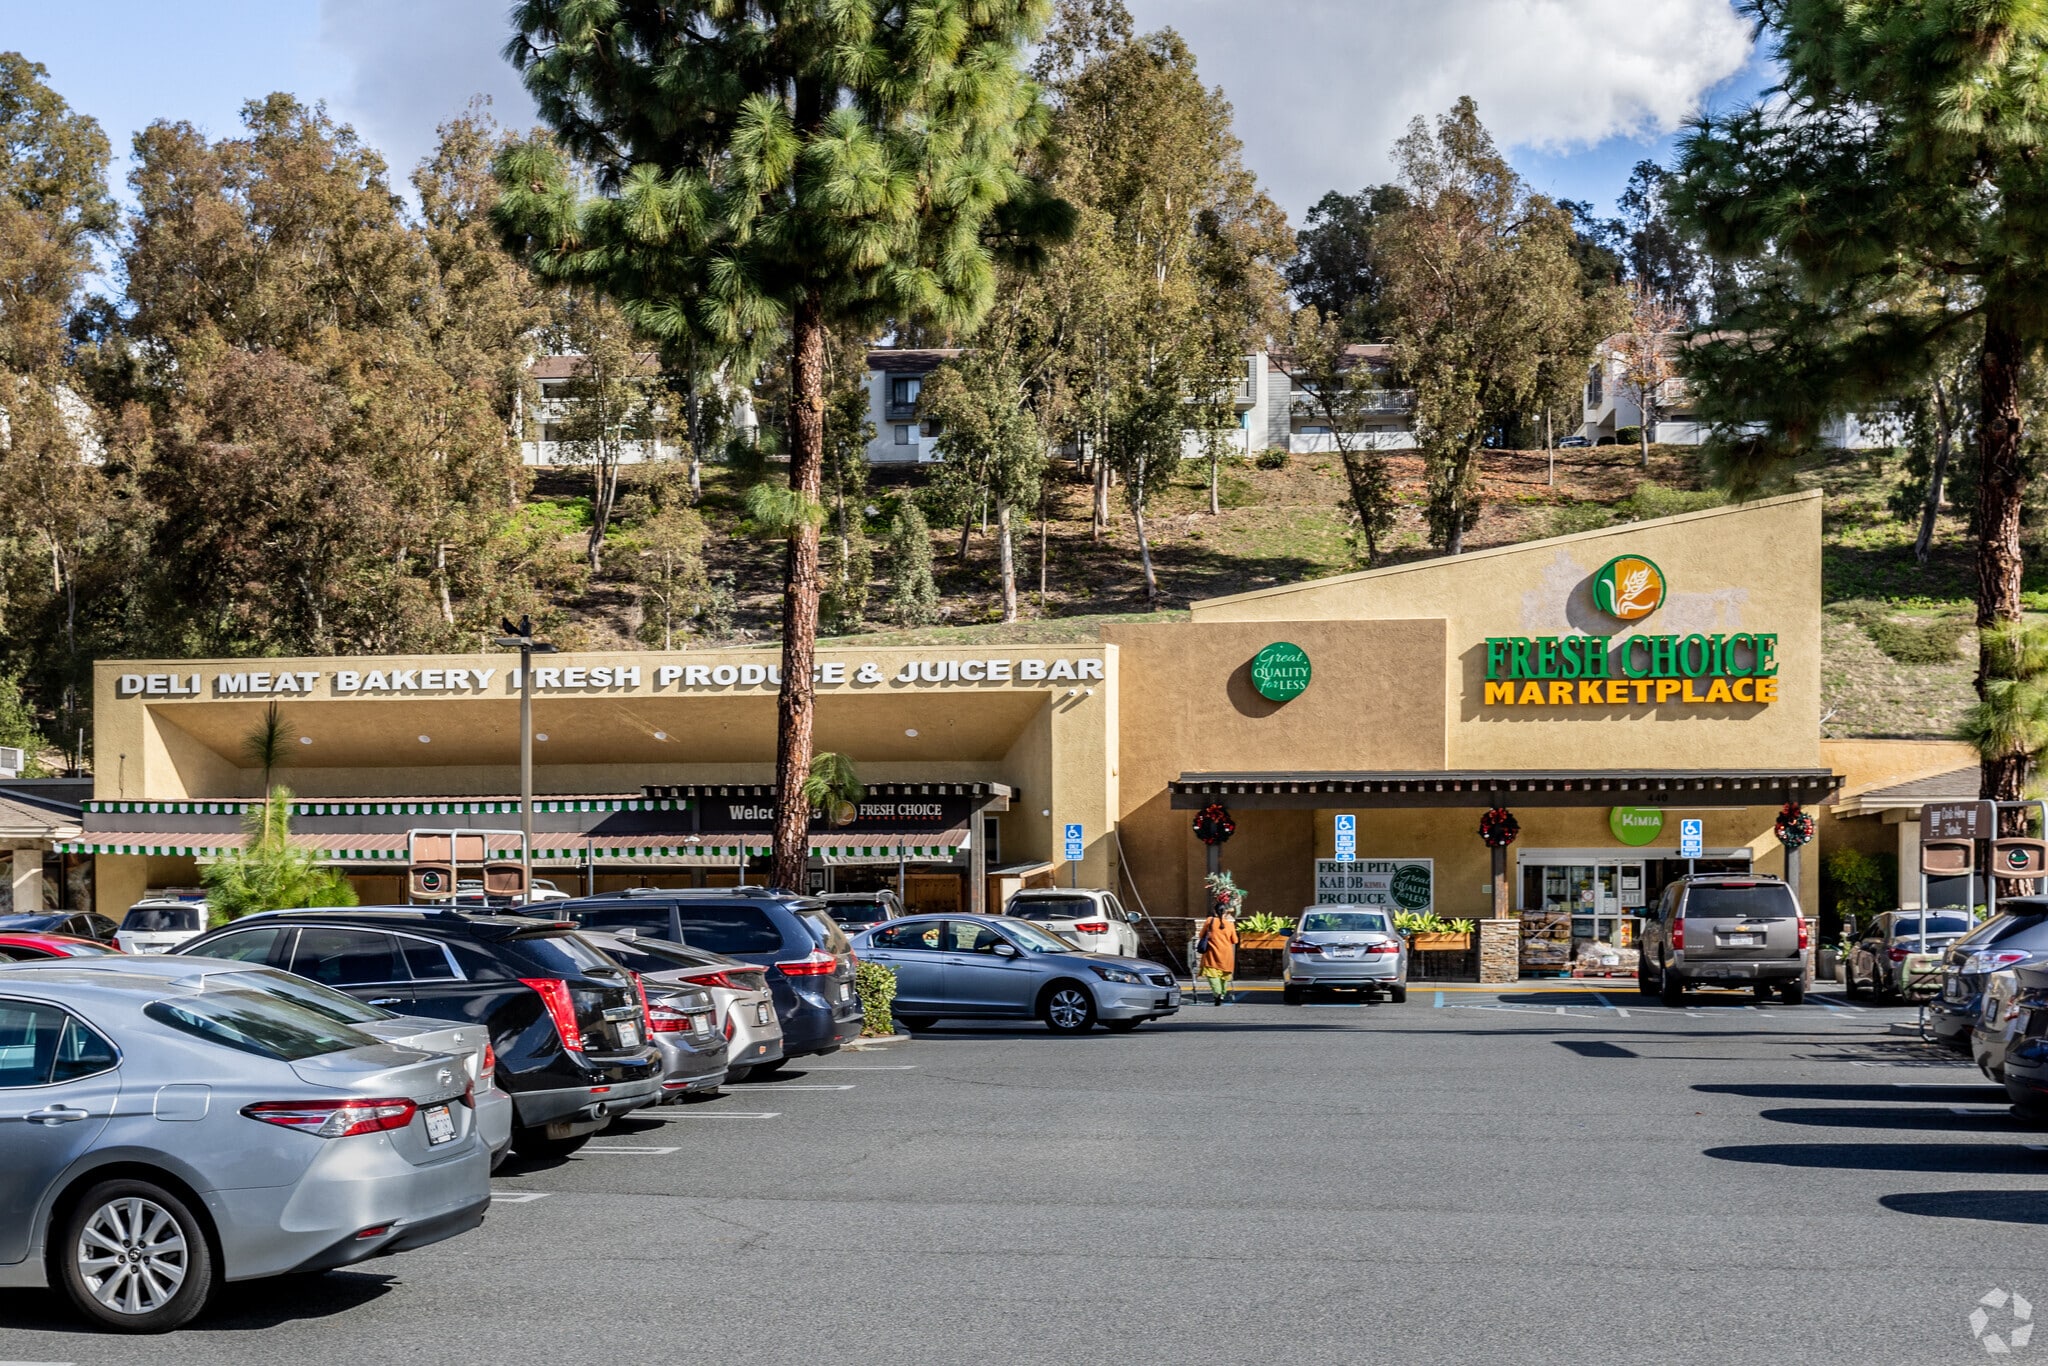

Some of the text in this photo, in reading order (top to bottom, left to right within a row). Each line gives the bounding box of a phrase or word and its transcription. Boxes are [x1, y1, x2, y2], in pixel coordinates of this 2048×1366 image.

[1259, 649, 1303, 669] Great
[1484, 632, 1779, 679] FRESH CHOICE
[121, 674, 200, 694] DELI
[219, 671, 320, 692] MEAT
[337, 668, 497, 691] BAKERY
[857, 662, 884, 684] &
[896, 660, 1011, 683] JUICE
[1021, 659, 1104, 680] BAR
[1254, 668, 1309, 680] QUALITY
[1260, 680, 1306, 693] for LESS
[1484, 678, 1779, 705] MARKETPLACE
[1648, 793, 1668, 801] 440
[860, 804, 942, 816] FRESH CHOICE
[1319, 862, 1399, 873] FRESH PITA
[1320, 876, 1387, 889] KABOB KIMIA
[1319, 893, 1386, 905] PRODUCE
